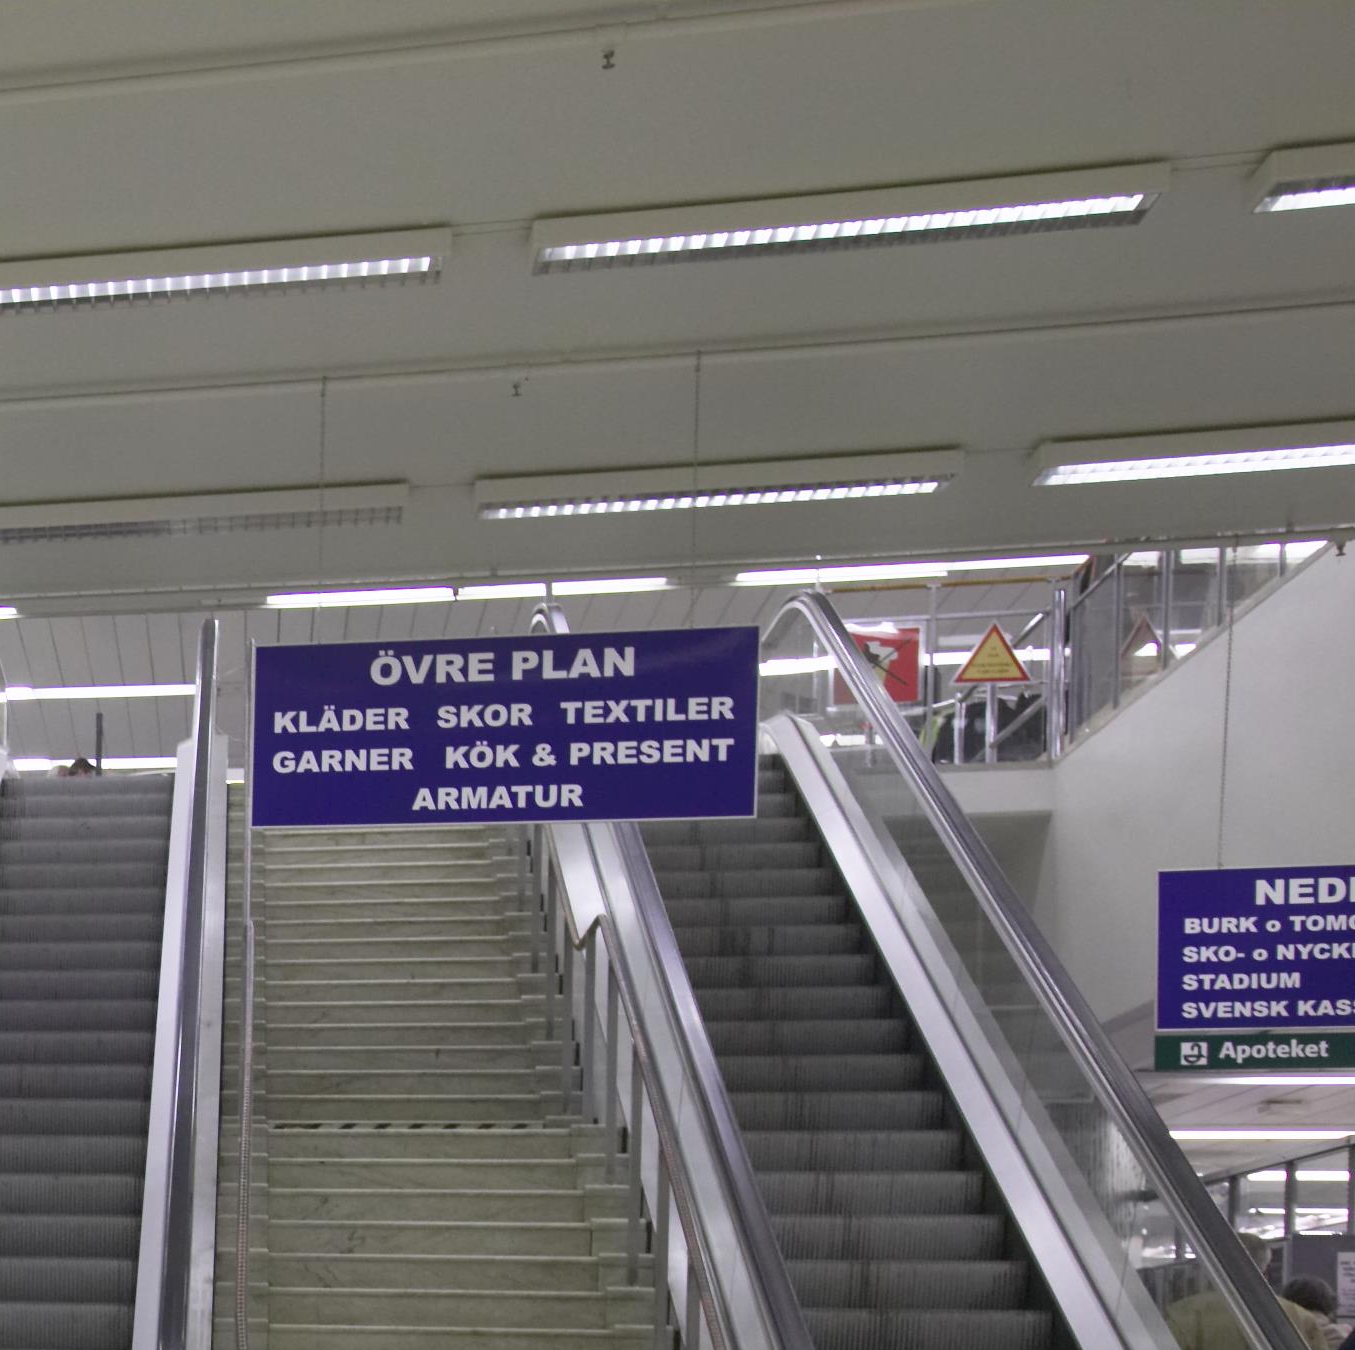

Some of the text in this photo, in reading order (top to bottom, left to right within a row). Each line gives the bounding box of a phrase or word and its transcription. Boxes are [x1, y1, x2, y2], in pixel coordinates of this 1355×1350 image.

[370, 646, 636, 686] ÖVRE PLAN
[274, 696, 735, 734] KLÄDER SKOR TEXTILER
[272, 738, 735, 774] GARNER KÖK & PRESENT
[411, 783, 584, 811] ARMATUR
[1255, 876, 1355, 906] NED
[1184, 916, 1259, 934] BURK
[1182, 945, 1245, 963] SKO-
[1277, 943, 1355, 960] NYCK
[1182, 972, 1301, 990] STADIUM
[1181, 999, 1355, 1018] SVENSK KAS
[1218, 1039, 1329, 1064] Apoteket
